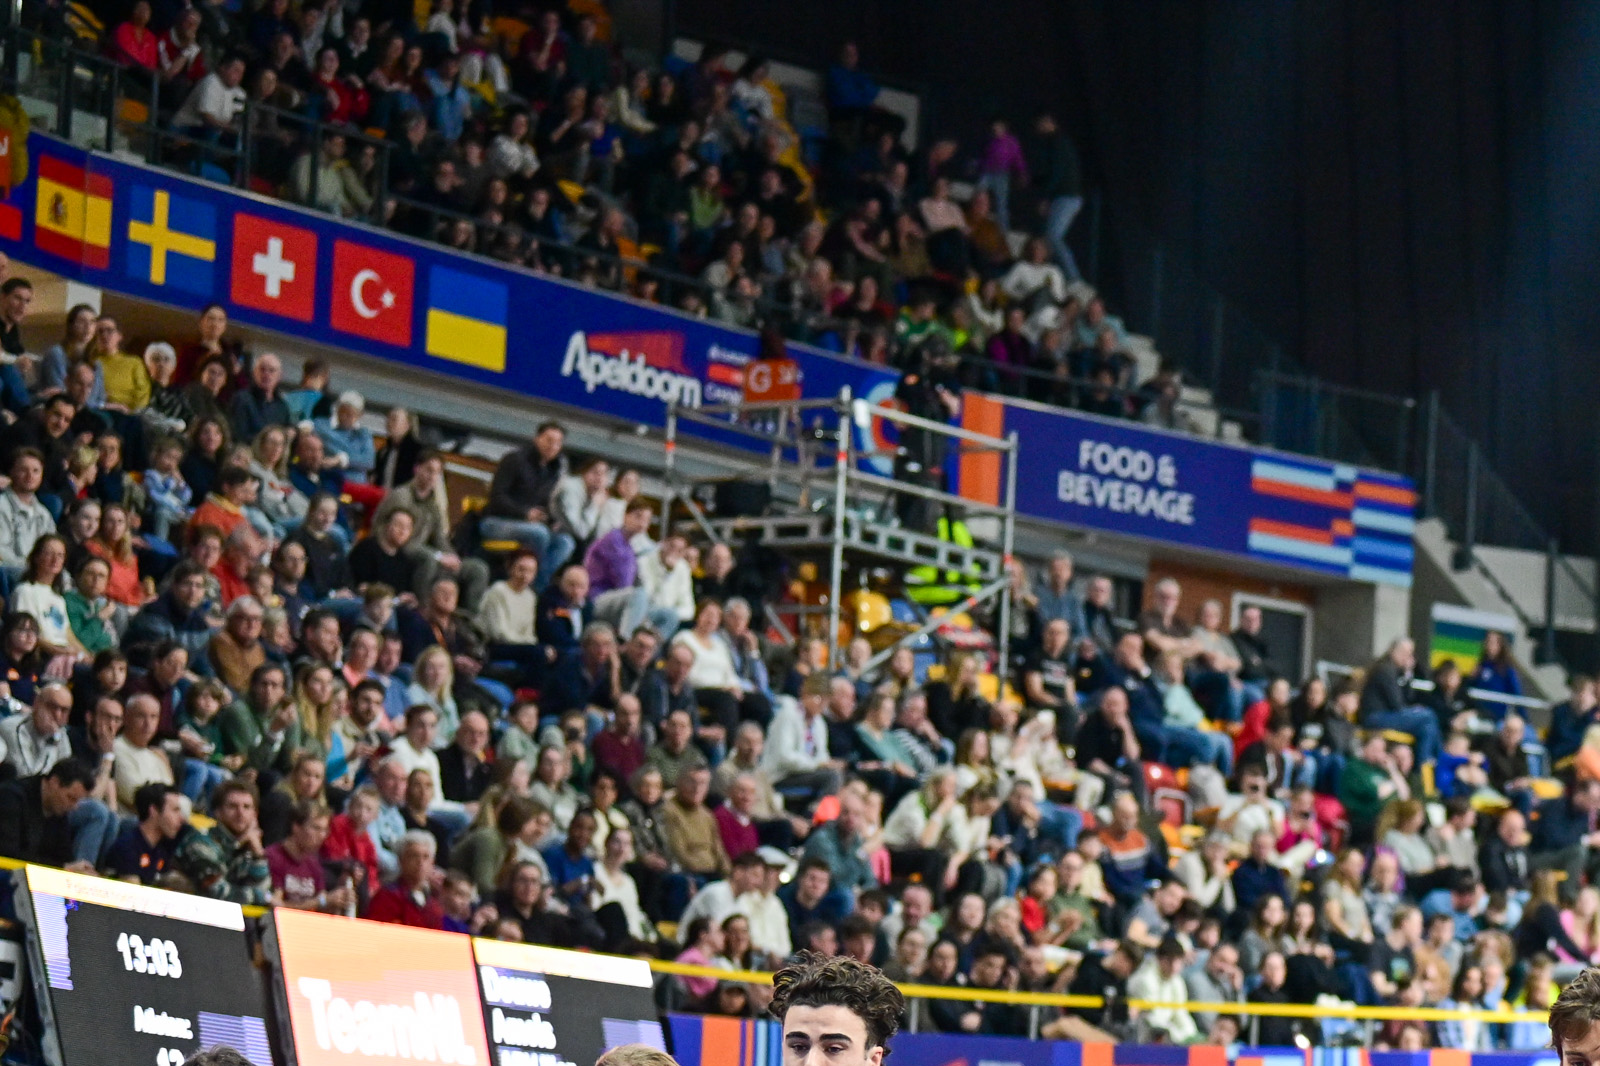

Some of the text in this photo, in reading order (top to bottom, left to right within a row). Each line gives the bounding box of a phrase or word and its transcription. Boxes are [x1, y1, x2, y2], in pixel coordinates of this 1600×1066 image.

[1079, 438, 1177, 488] FOOD &
[1058, 470, 1195, 525] BEVERAGE
[117, 932, 182, 978] 13:03
